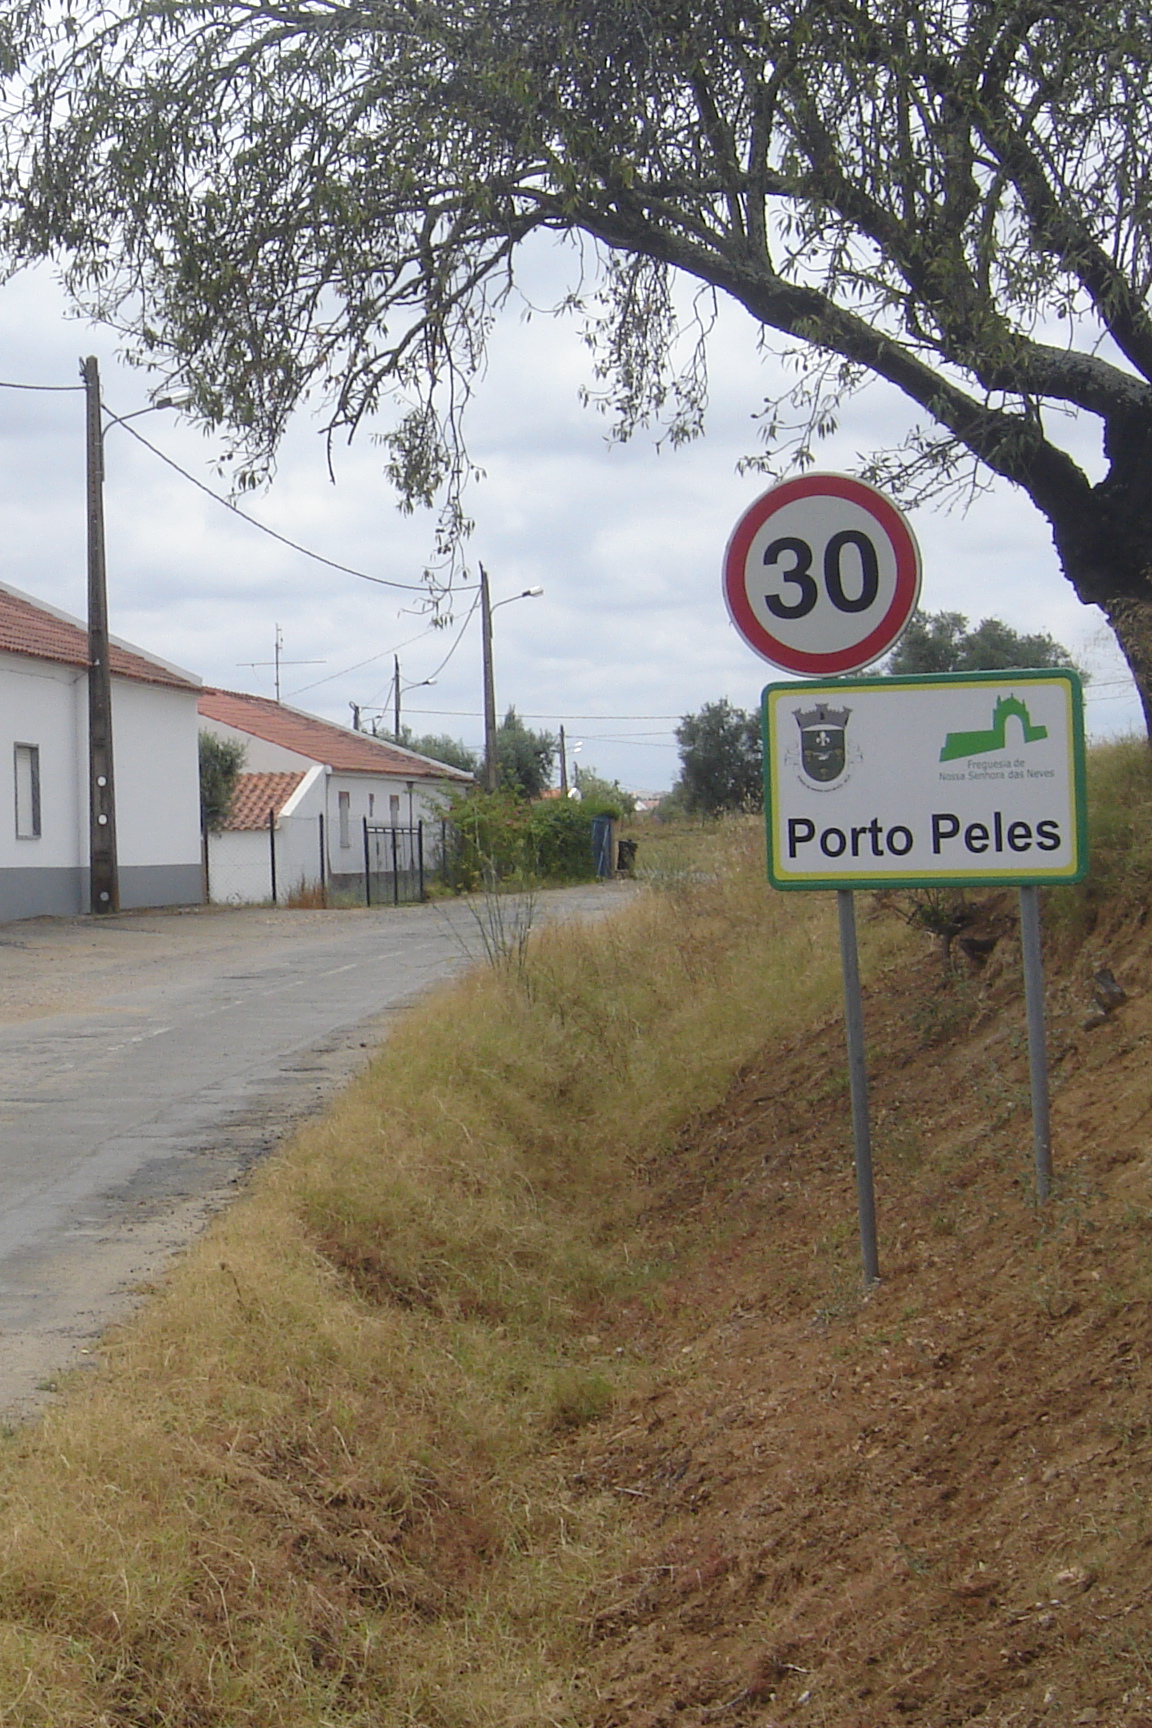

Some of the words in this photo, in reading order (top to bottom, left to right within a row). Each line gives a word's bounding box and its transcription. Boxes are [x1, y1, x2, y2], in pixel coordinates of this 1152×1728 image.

[762, 529, 879, 619] 30
[939, 772, 965, 781] Nossa
[968, 771, 1005, 780] Senhora
[1008, 769, 1024, 779] das
[1027, 769, 1055, 778] Neves
[967, 759, 1012, 771] Freguesia
[1014, 758, 1025, 768] de
[787, 817, 914, 858] Porto
[931, 811, 1062, 854] Peles
